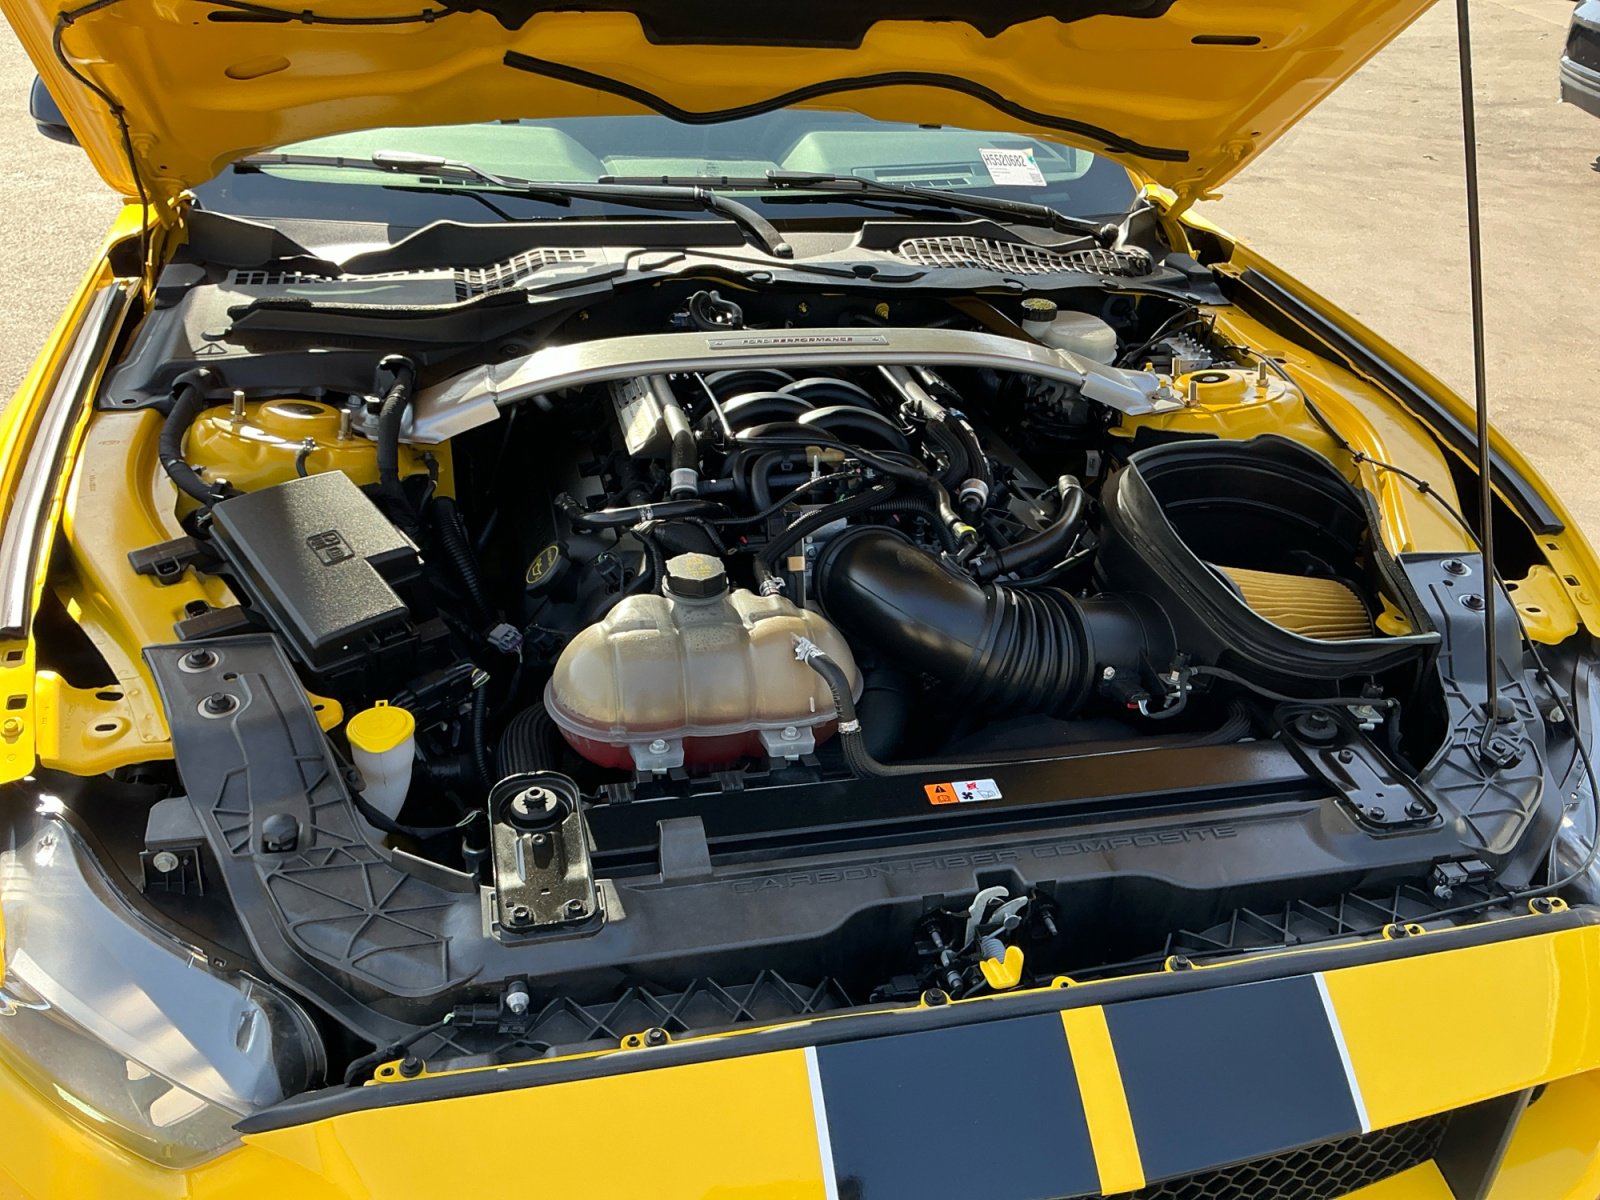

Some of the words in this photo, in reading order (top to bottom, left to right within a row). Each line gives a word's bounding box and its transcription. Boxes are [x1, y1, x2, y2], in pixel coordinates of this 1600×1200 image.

[983, 154, 1027, 167] H5520682
[732, 849, 1020, 893] CARBON-FIBER
[1033, 825, 1239, 859] COMPOSITE
